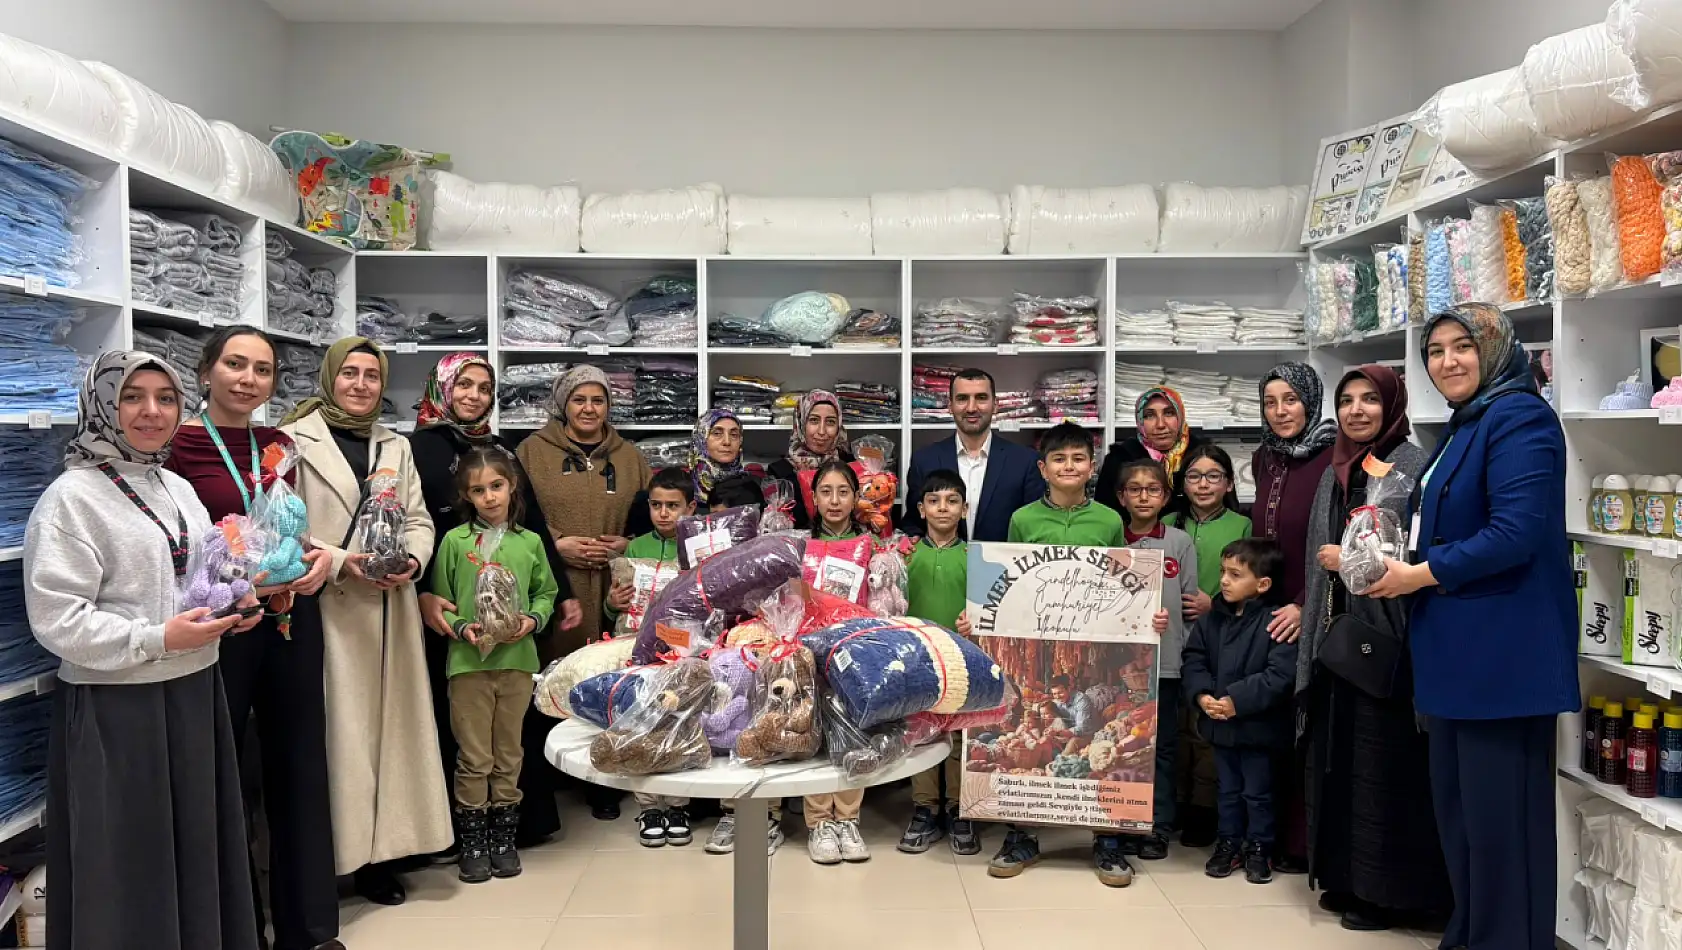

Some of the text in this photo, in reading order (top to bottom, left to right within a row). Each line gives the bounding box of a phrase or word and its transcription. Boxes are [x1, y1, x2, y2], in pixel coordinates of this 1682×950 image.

[975, 545, 1148, 632] İLMEK İLMEK SEVGİ
[1034, 590, 1103, 624] Cumhuriyet
[1586, 602, 1610, 644] Sleepy
[1637, 611, 1663, 654] Sleepy
[1028, 780, 1052, 789] ilmek
[1053, 780, 1078, 790] ilmek
